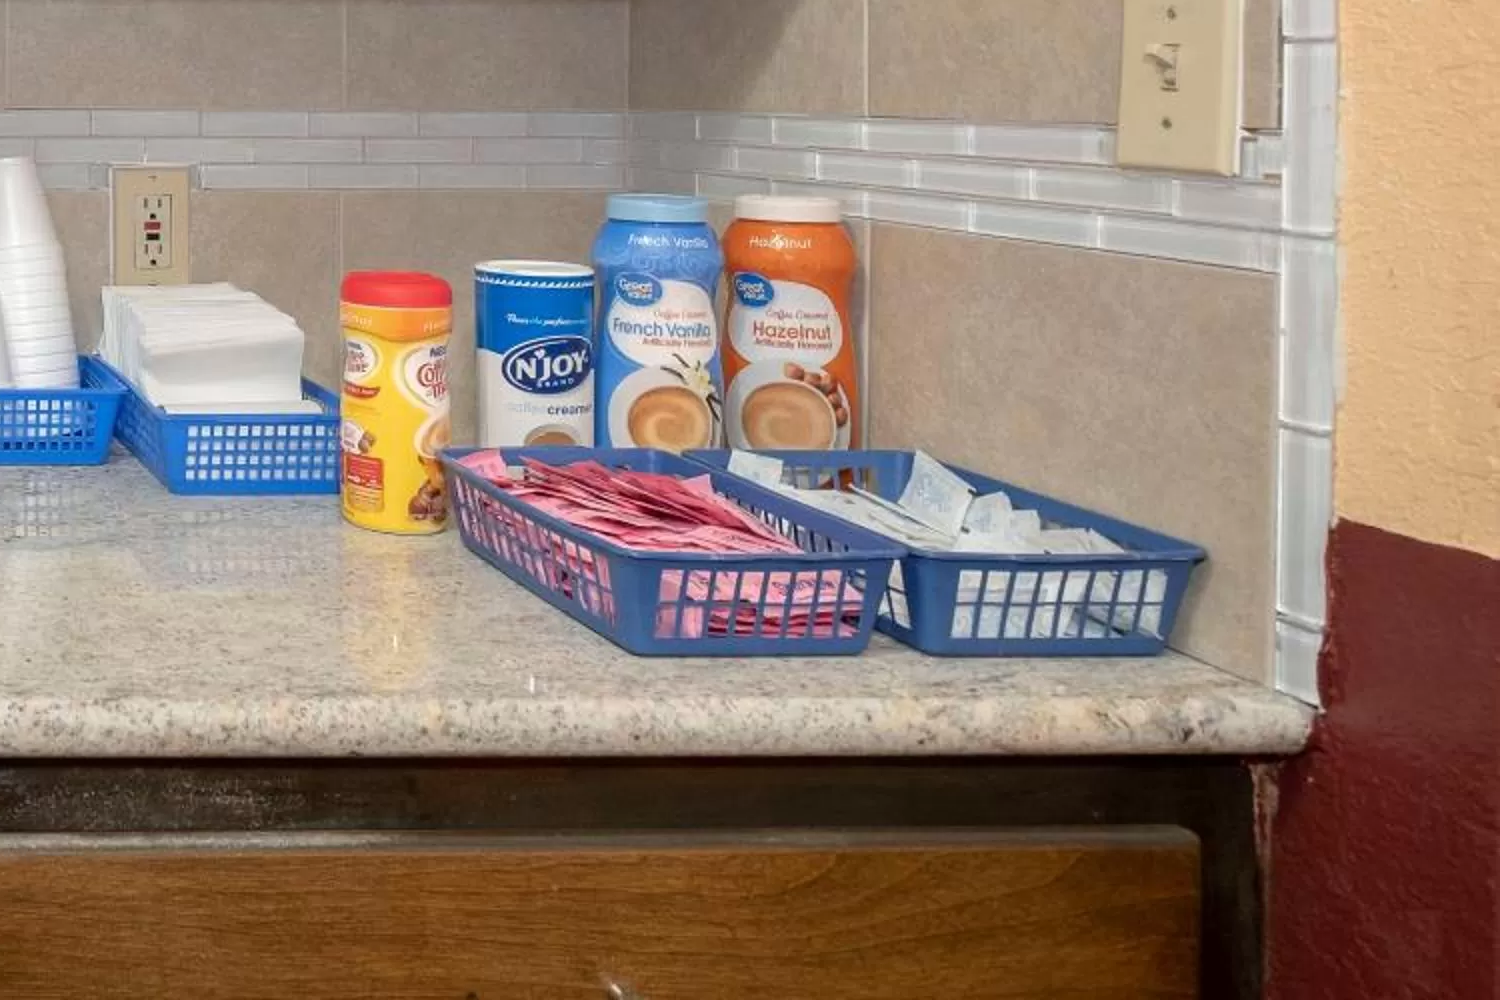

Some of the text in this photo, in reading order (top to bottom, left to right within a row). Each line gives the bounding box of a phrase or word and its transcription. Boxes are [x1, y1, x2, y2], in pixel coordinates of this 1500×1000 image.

[612, 317, 711, 338] French Vanilla
[753, 319, 831, 340] Hazelnut
